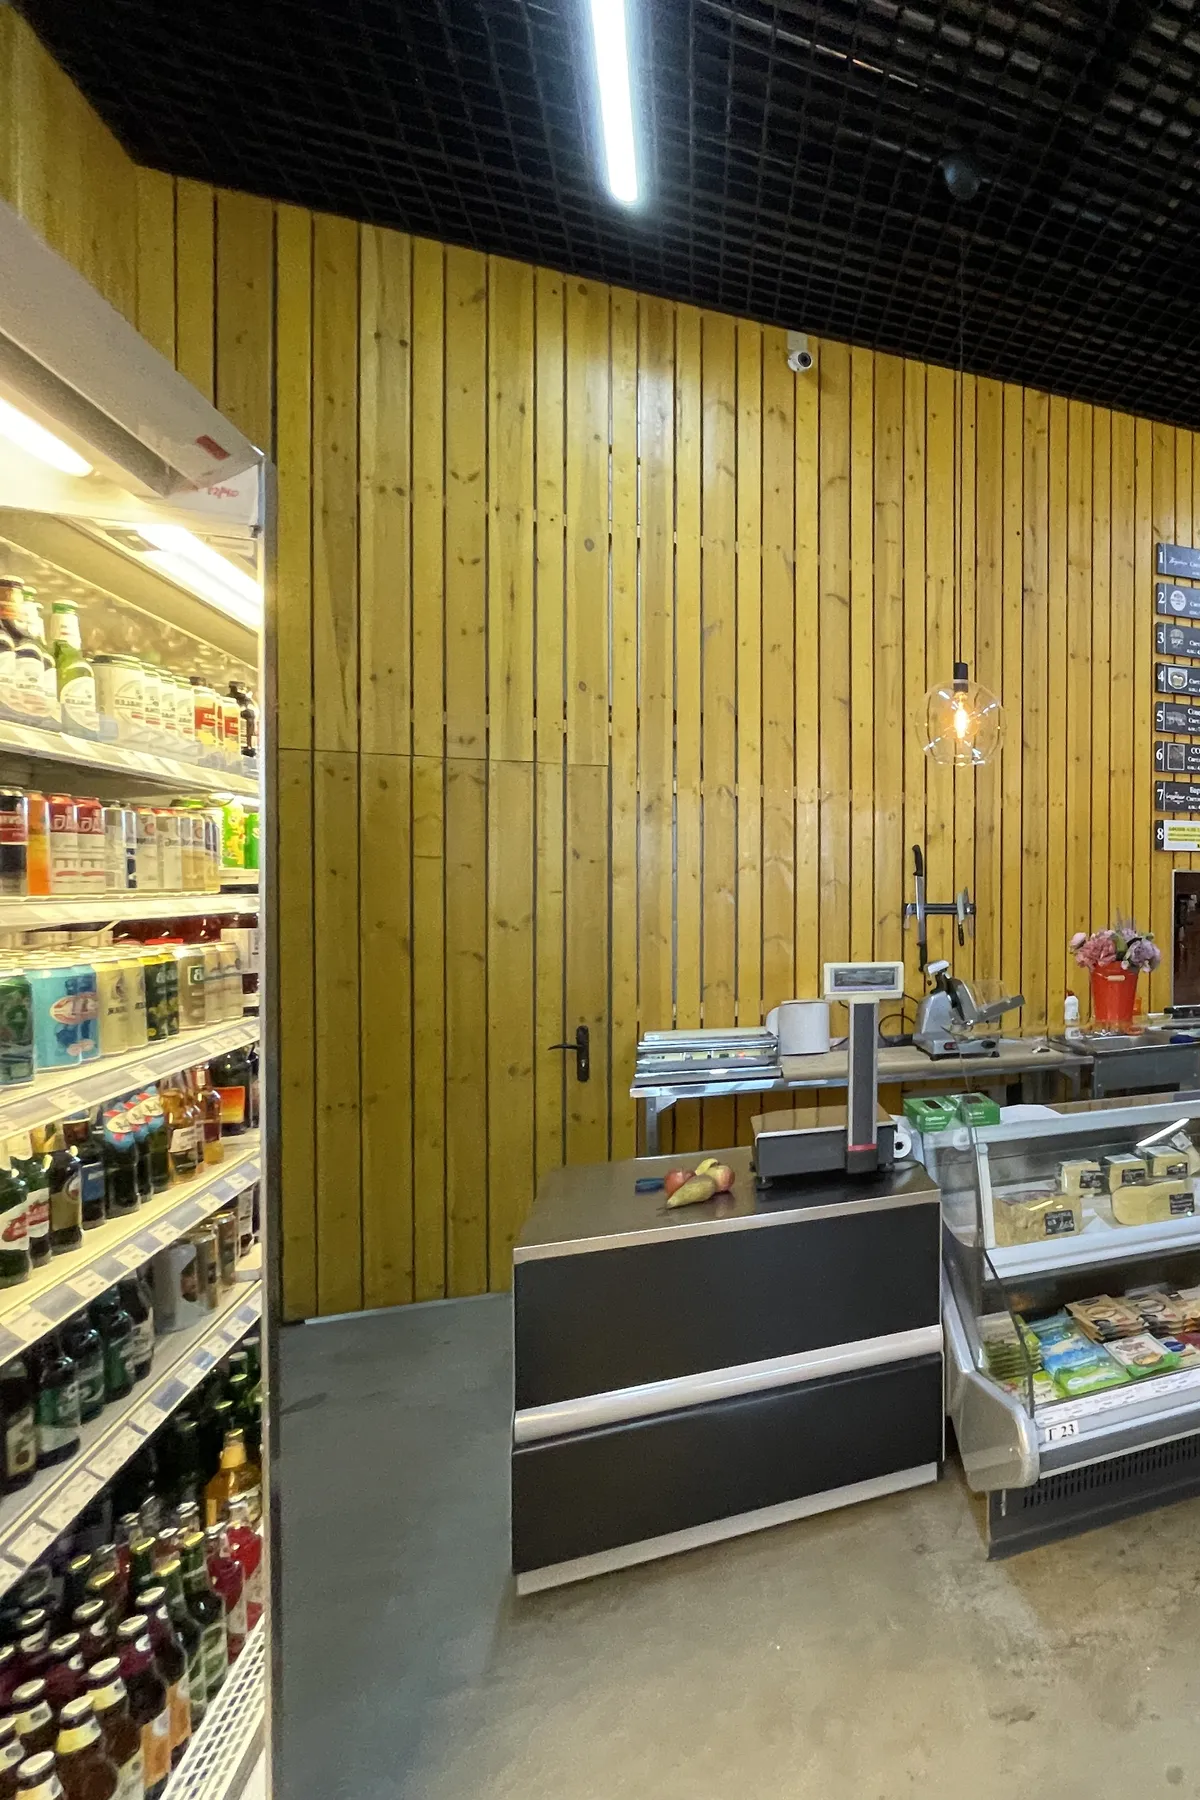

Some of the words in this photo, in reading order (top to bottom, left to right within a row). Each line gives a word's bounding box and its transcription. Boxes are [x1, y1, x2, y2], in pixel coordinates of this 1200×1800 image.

[1159, 552, 1164, 564] 1
[1158, 592, 1165, 604] 2
[1157, 632, 1164, 644] 3
[1157, 671, 1164, 682] 4
[1156, 711, 1163, 723] 5
[1156, 748, 1163, 761] 6
[1157, 789, 1164, 801] 7
[1157, 827, 1164, 840] 8
[1049, 1428, 1057, 1440] Г
[1061, 1424, 1074, 1438] 23
